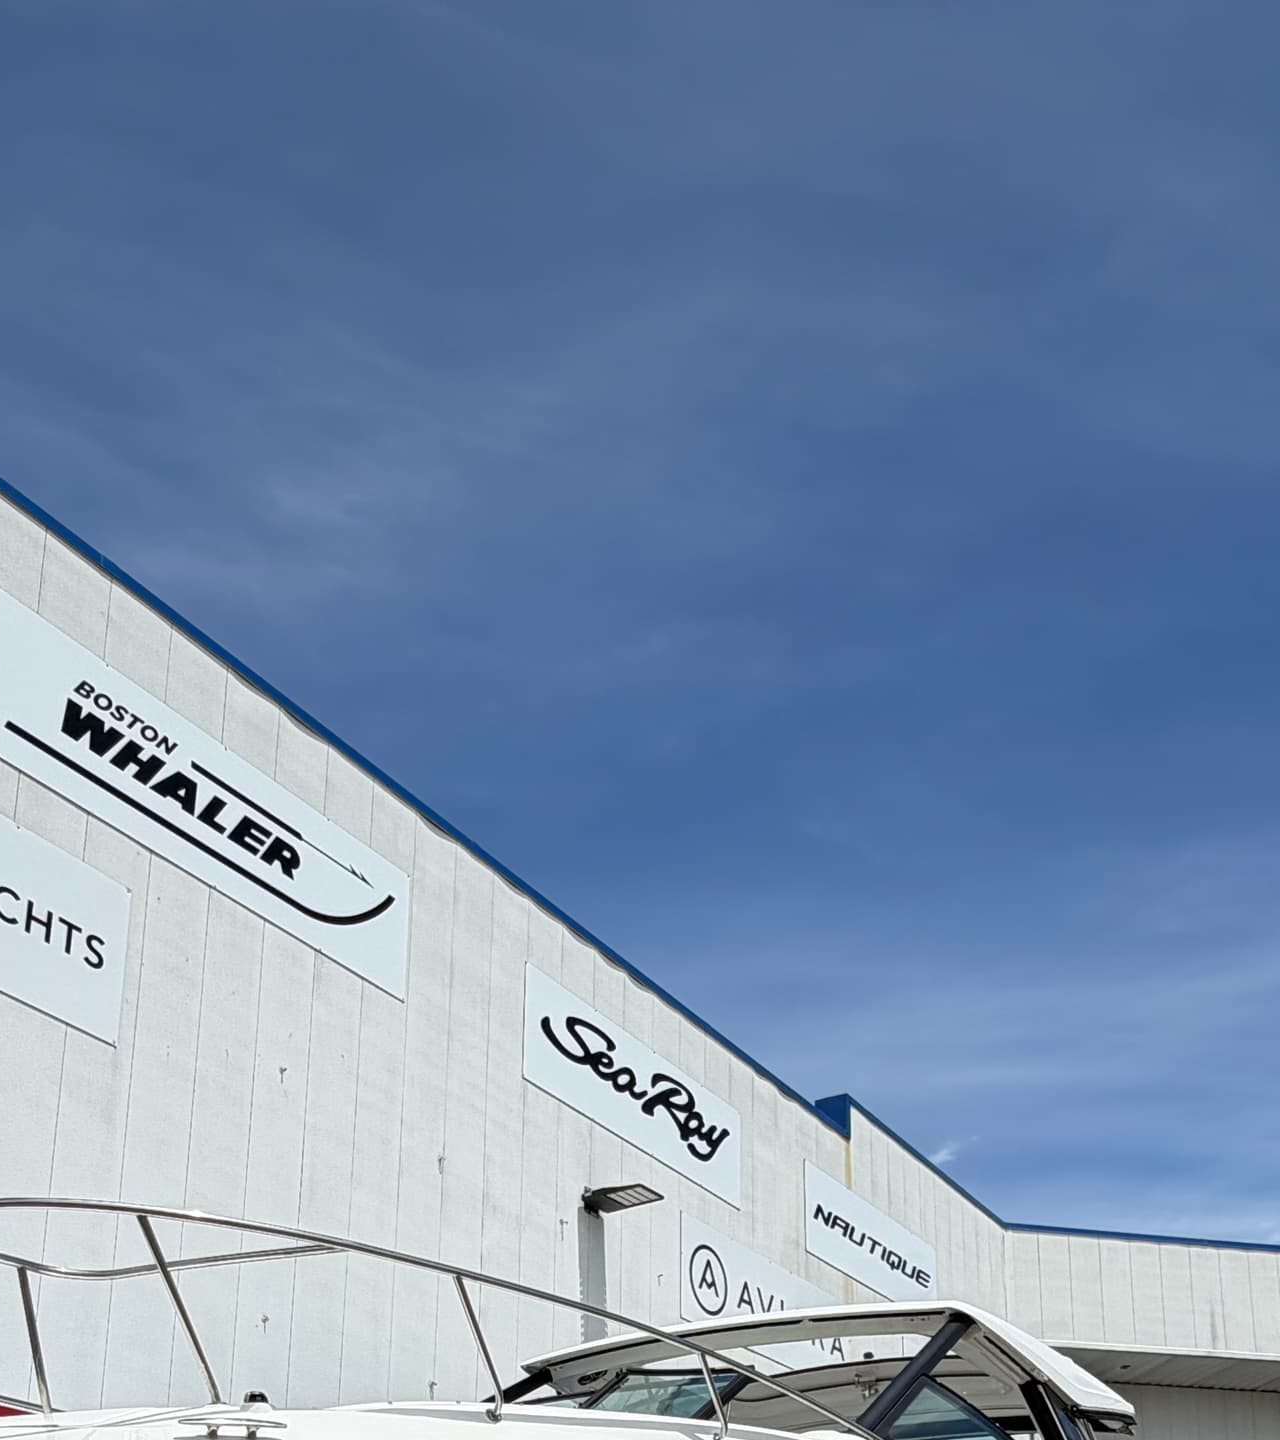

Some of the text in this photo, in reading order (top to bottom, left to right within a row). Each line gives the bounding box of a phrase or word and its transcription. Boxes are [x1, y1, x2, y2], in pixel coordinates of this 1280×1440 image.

[73, 680, 179, 756] BOSTON
[61, 697, 303, 882] WHALER
[540, 1015, 731, 1162] Sea Ray
[813, 1203, 932, 1289] NAUTIQUE
